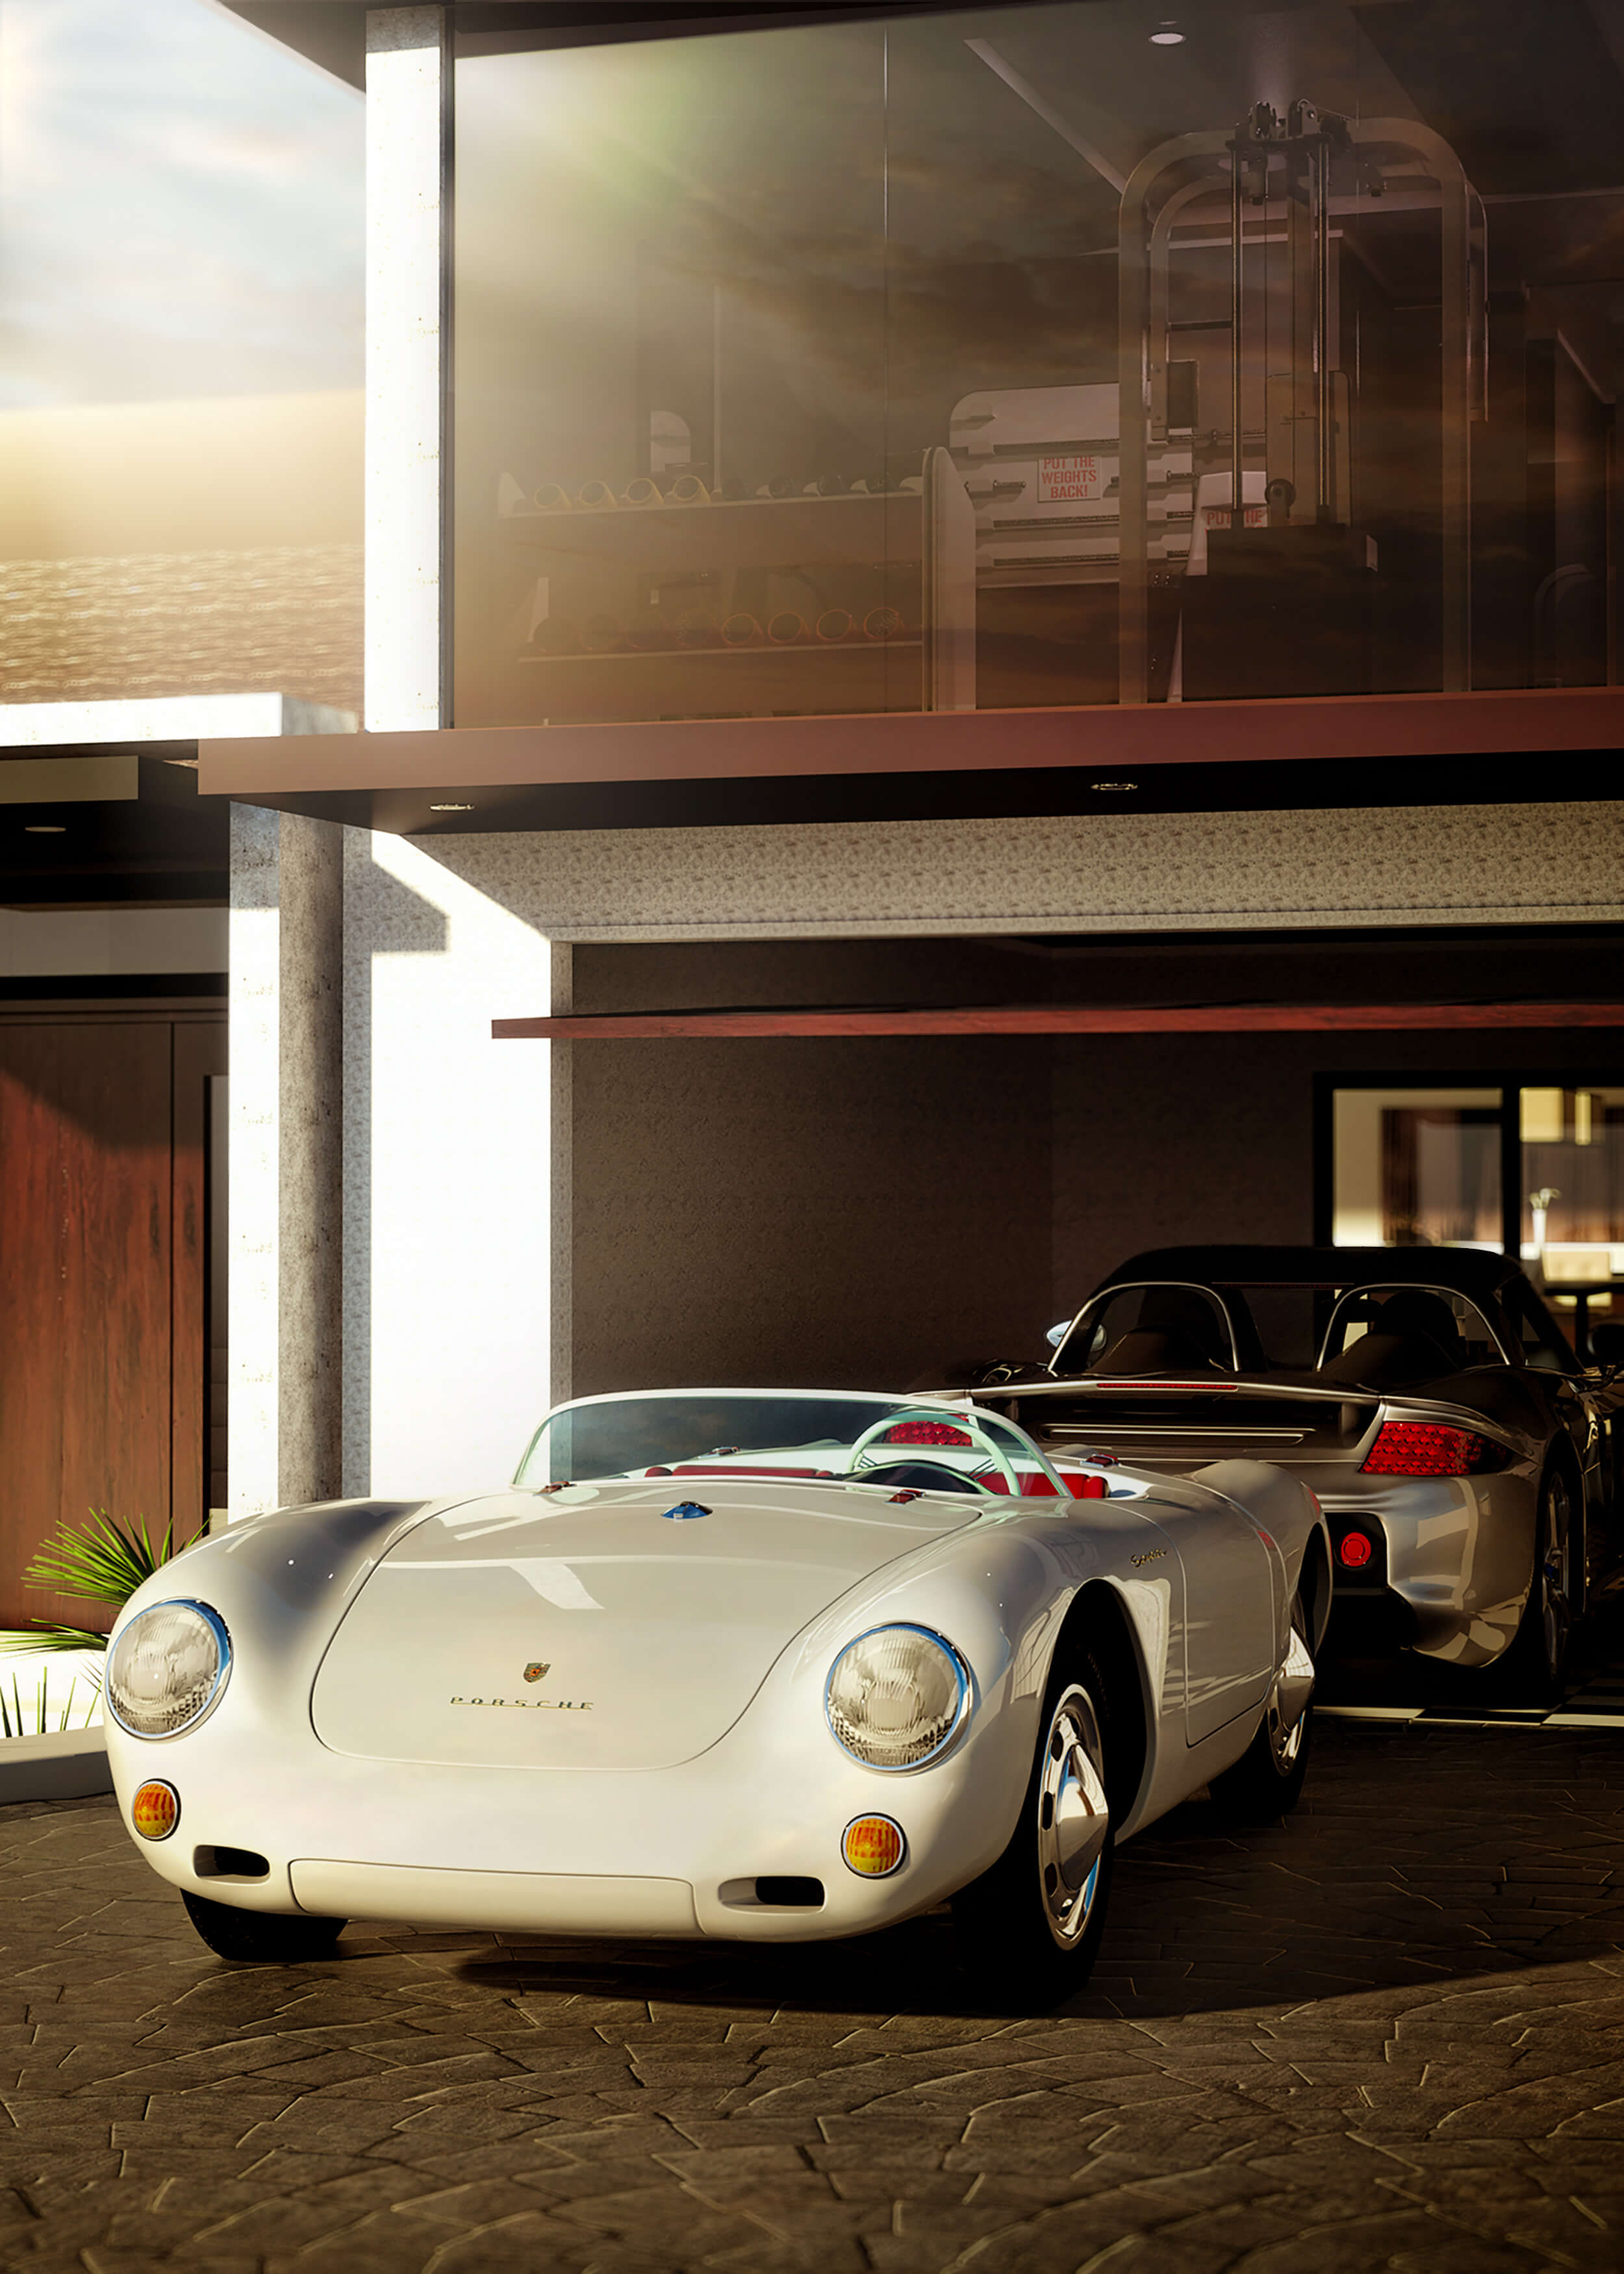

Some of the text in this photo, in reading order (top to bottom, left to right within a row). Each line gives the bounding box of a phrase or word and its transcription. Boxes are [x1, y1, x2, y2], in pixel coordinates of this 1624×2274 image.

[1044, 455, 1095, 469] PUT THE
[1041, 469, 1097, 484] WEIGHTS
[1050, 485, 1087, 499] BACK!
[1245, 509, 1263, 524] HE
[450, 1696, 594, 1710] PORSCHE
